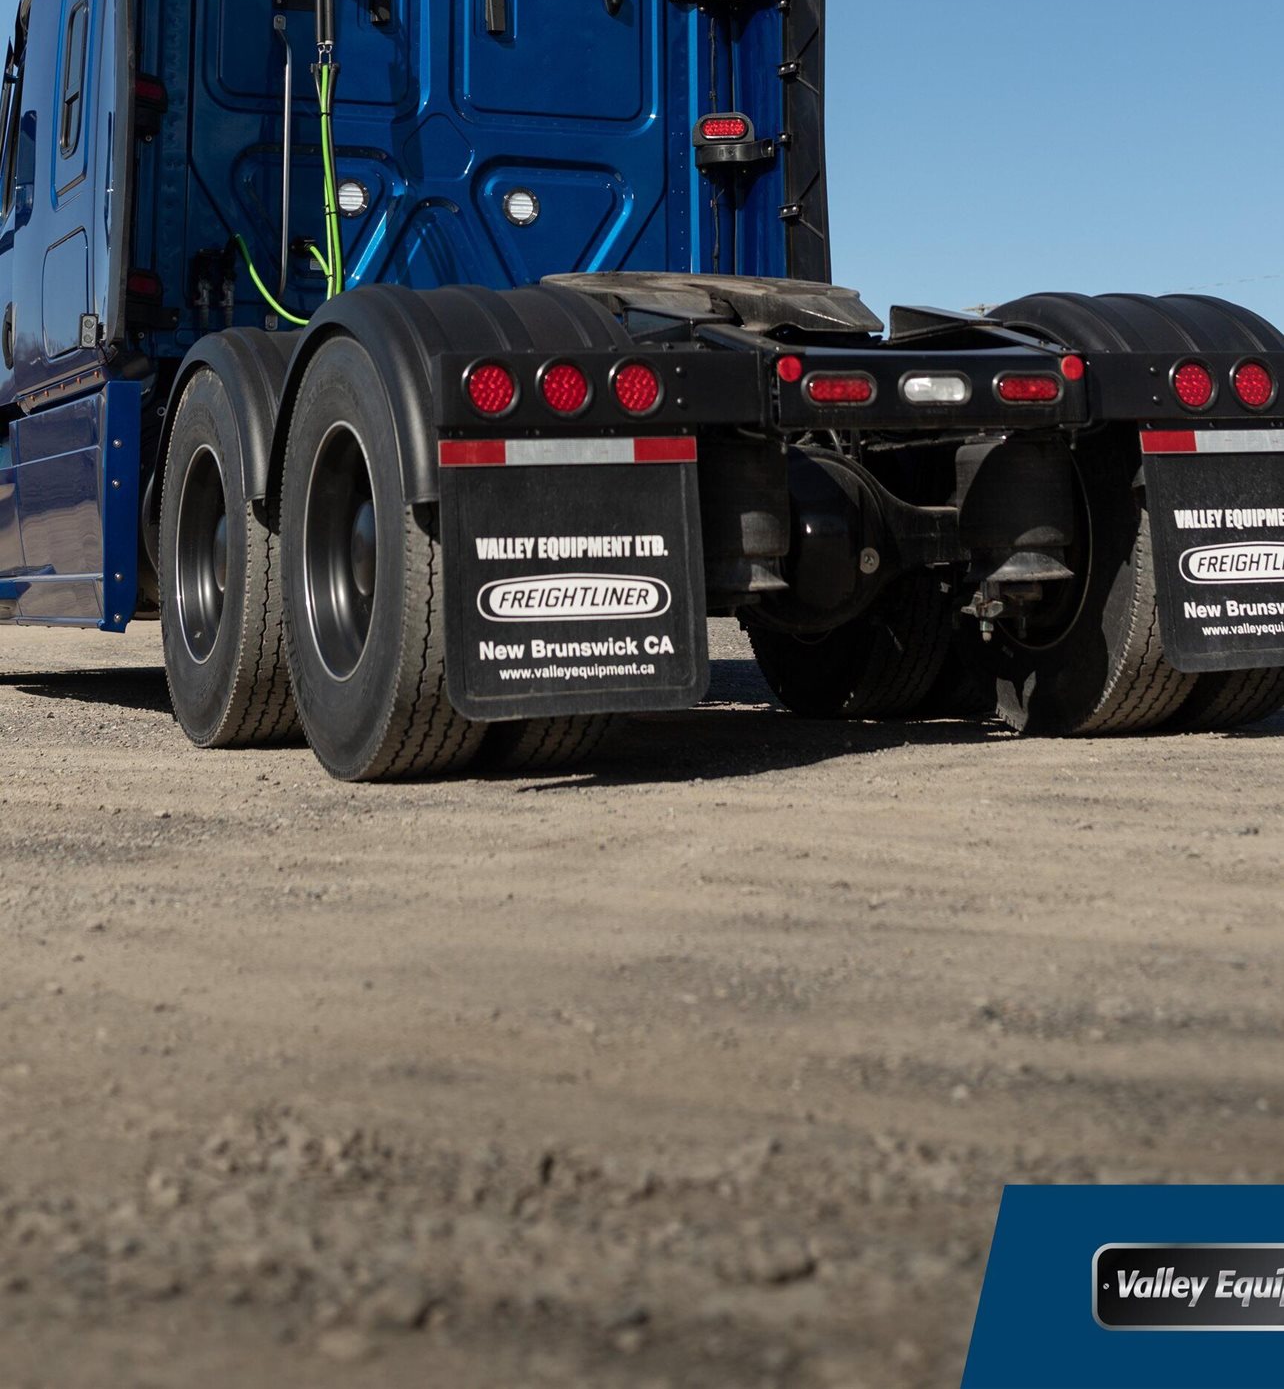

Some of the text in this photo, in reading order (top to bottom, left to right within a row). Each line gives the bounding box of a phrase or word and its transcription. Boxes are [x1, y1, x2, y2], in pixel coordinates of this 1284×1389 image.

[1174, 509, 1222, 529] VALLEY
[475, 535, 669, 560] VALLEY EQUIPMENT LTD.
[499, 587, 649, 609] FREIGHTLINER
[1184, 601, 1221, 619] New
[479, 635, 675, 660] New Brunswick CA
[499, 663, 655, 680] www.valleyequipment.ca
